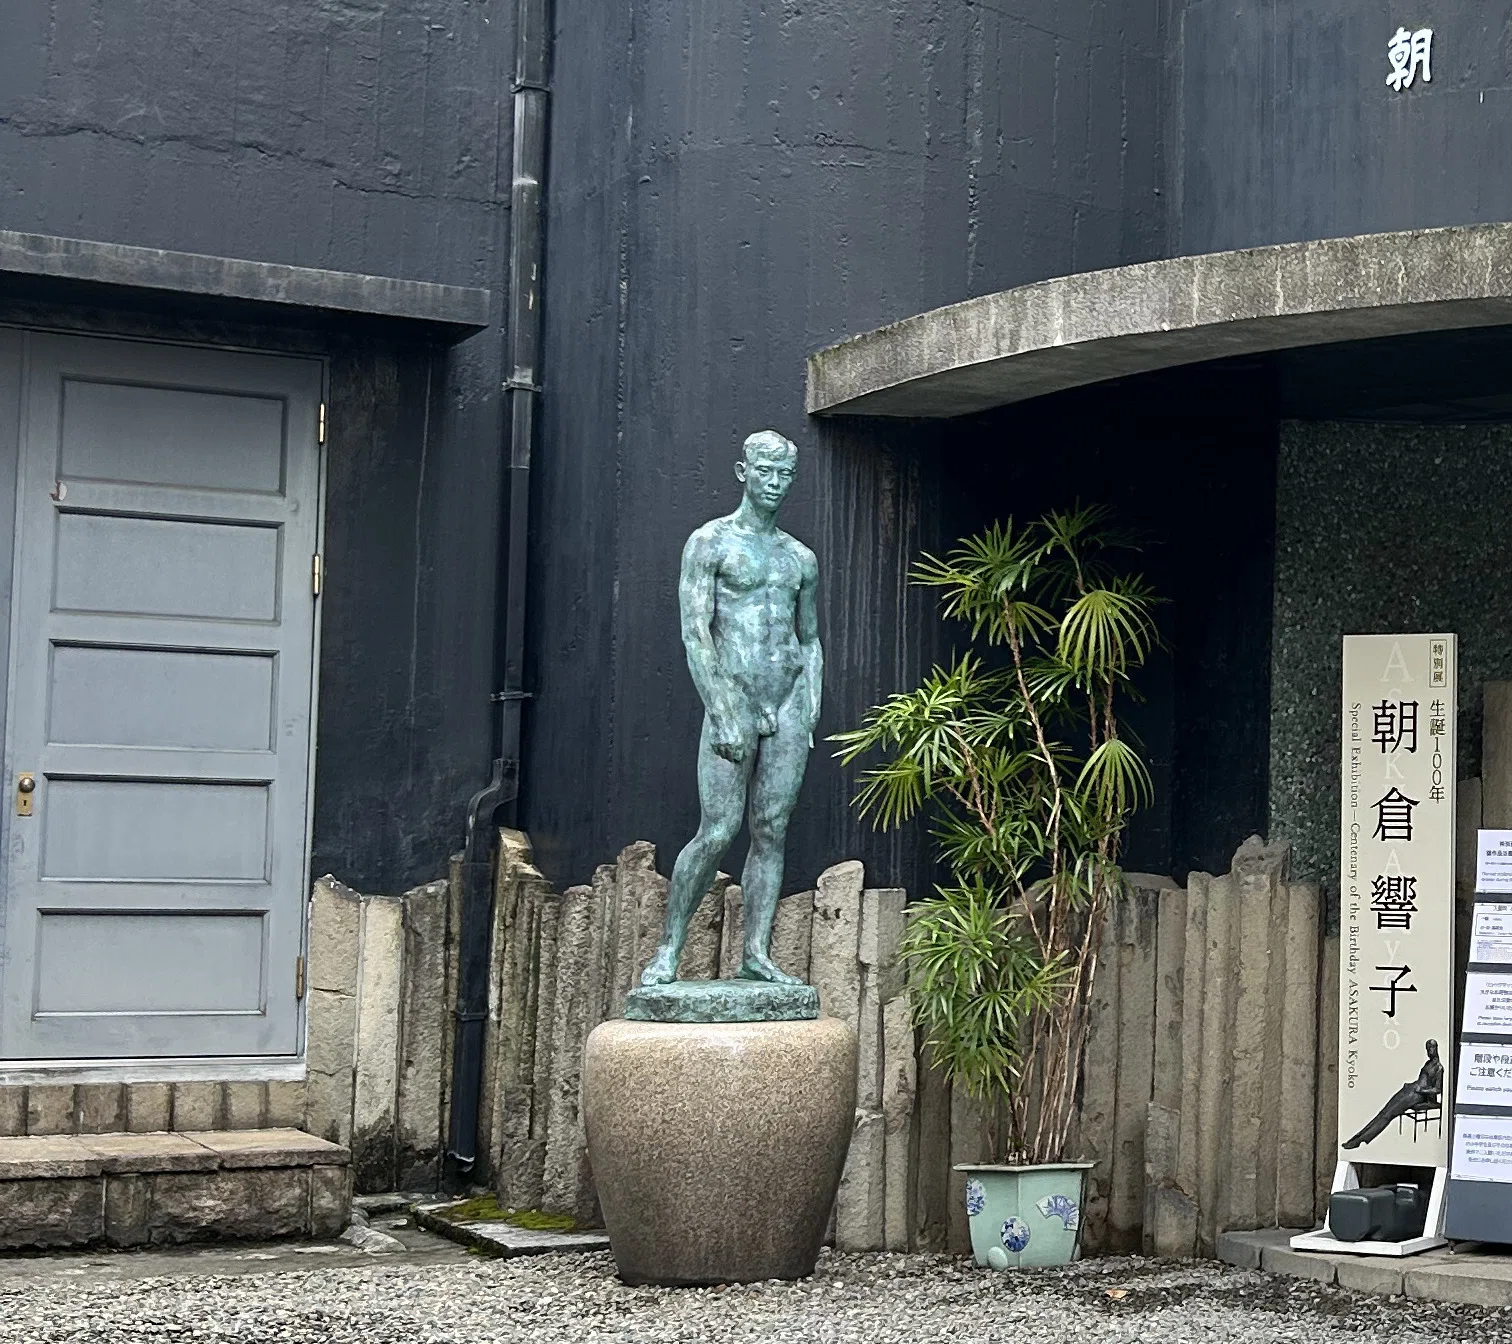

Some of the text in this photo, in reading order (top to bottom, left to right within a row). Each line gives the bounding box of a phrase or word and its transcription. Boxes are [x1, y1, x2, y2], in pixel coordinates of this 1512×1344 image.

[1349, 702, 1362, 742] Special
[1369, 699, 1421, 1019] 朝倉響子
[1349, 885, 1362, 901] of
[1349, 905, 1361, 921] the
[1347, 926, 1360, 974] Birthday
[1348, 979, 1359, 1045] ASAKURA
[1347, 1049, 1358, 1089] Kyoko
